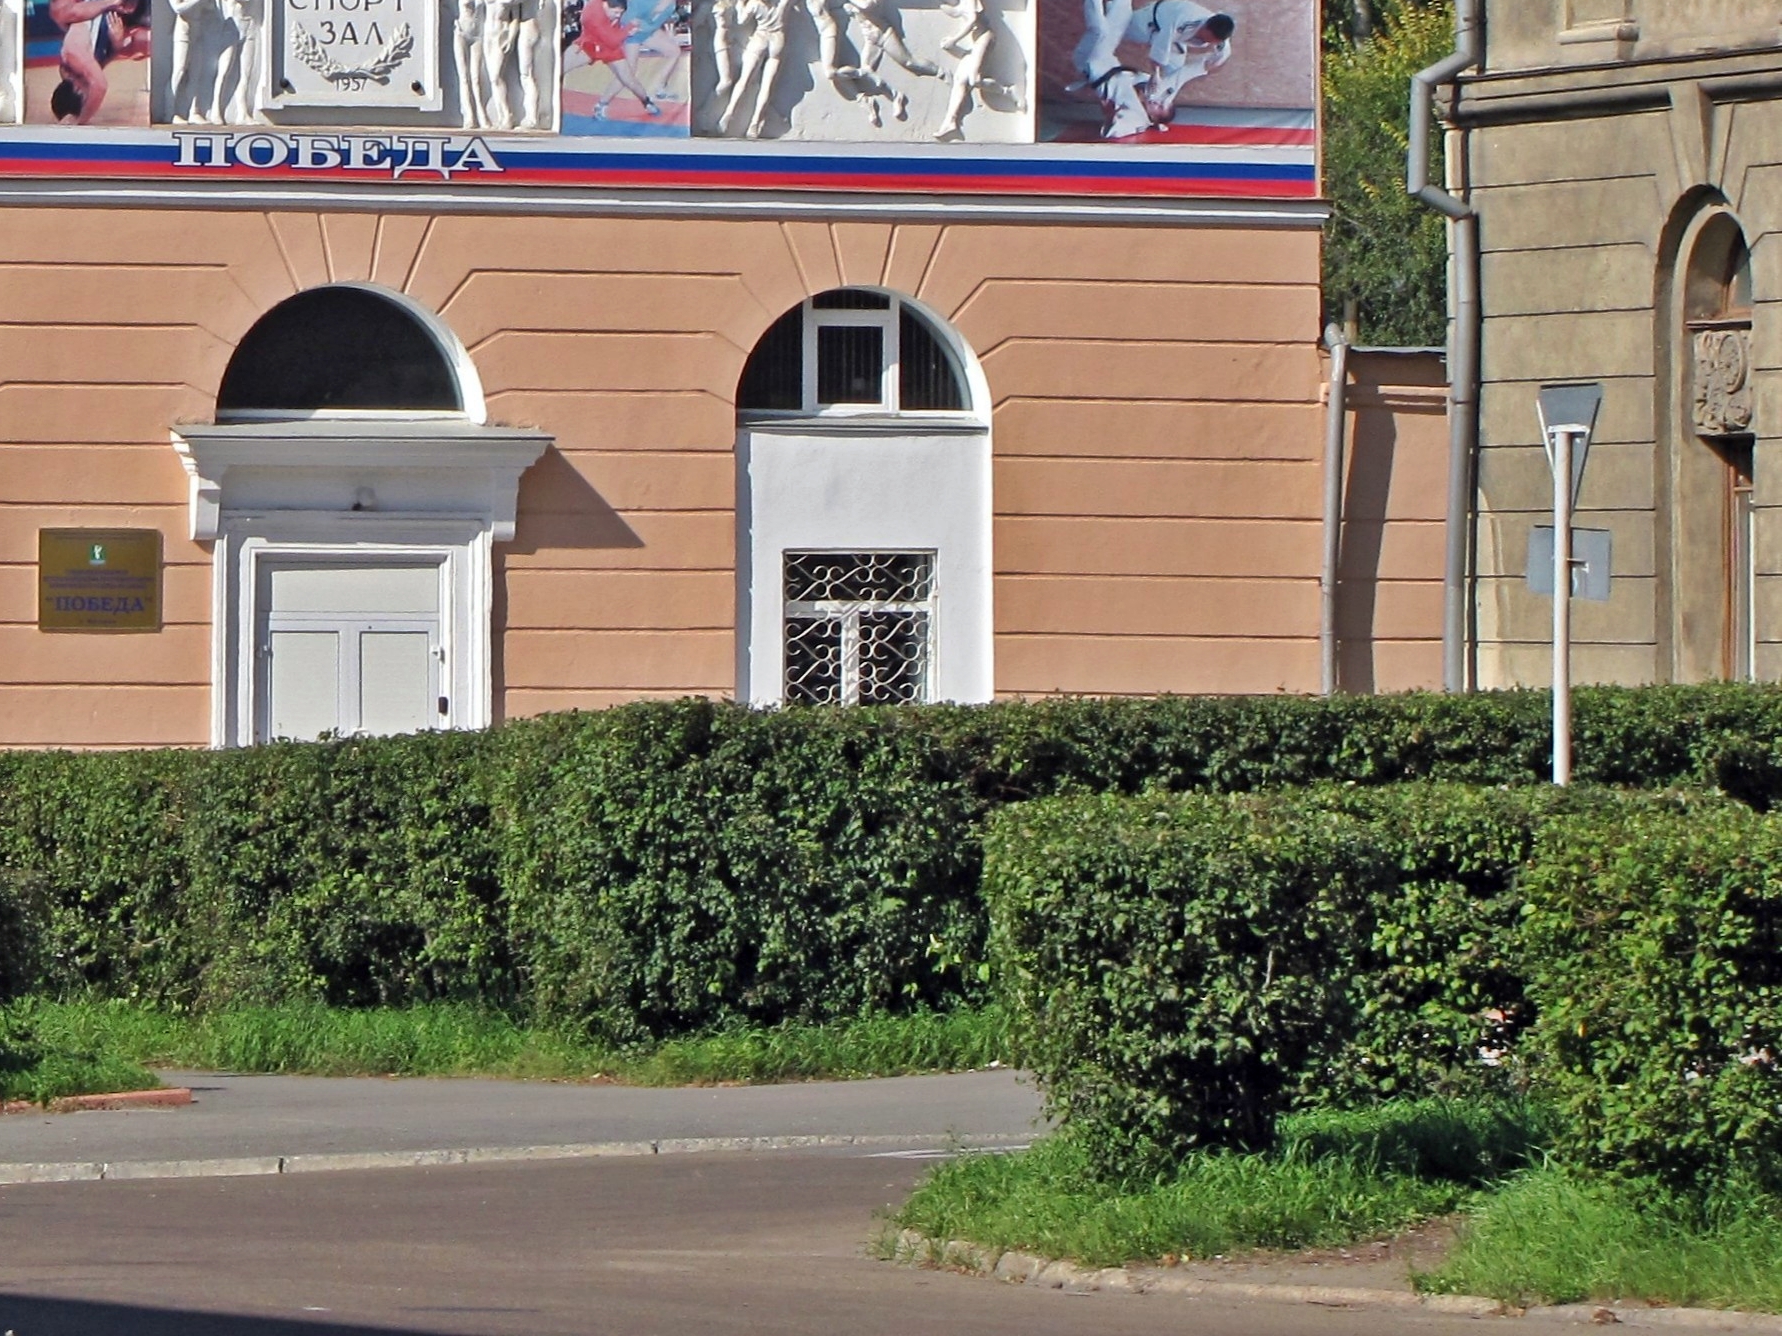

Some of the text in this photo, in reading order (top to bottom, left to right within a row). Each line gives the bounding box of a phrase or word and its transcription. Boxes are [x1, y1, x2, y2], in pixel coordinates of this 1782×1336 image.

[320, 21, 384, 45] ЗАЛ
[335, 77, 367, 91] 1957
[171, 131, 505, 180] ПОБЕДА
